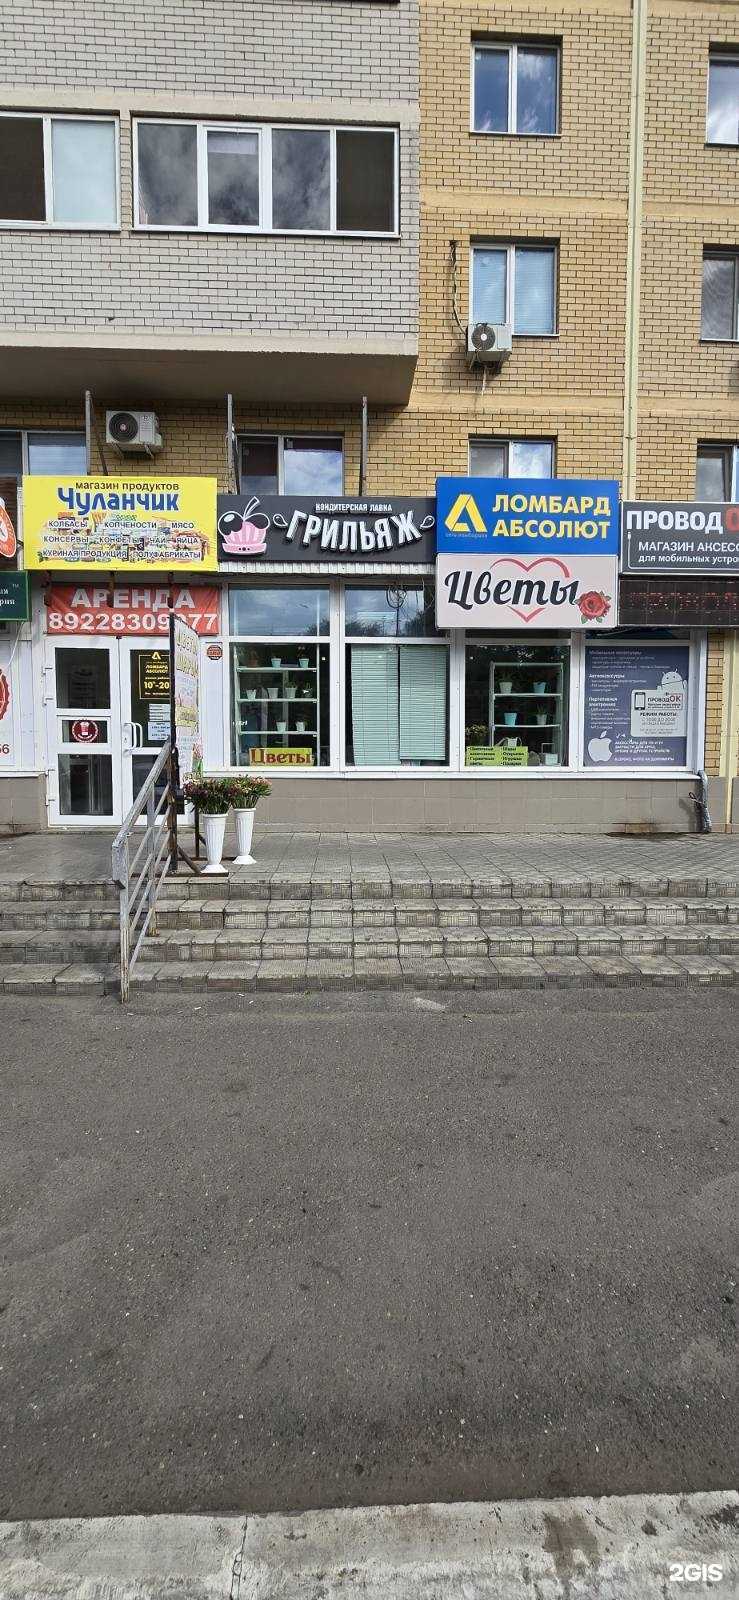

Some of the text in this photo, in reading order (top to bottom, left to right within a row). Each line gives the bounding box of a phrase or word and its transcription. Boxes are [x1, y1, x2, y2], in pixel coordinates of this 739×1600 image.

[76, 482, 180, 492] магазин продуктов
[58, 488, 180, 516] Чуланчик
[316, 504, 392, 512] КОНДИТЕРСКАЯ ЛАВКА
[492, 494, 611, 516] ЛОМБАРД
[48, 520, 88, 528] КОЛБАСЫ
[286, 510, 423, 552] ГРИЛЬЯЖ
[492, 520, 610, 540] АБСОЛЮТ
[99, 536, 140, 544] КОНФЕТЫ
[176, 536, 199, 545] ЯЙЦА
[638, 542, 696, 552] МАГАЗИН
[43, 550, 79, 558] КУРИНАЯ
[81, 550, 127, 560] ПРОДУКЦИЯ
[638, 555, 656, 564] для
[658, 553, 710, 564] мобильных
[70, 588, 196, 612] АРЕНДА
[444, 571, 580, 612] Цветы
[48, 612, 218, 631] 8922830977
[251, 748, 311, 765] Цветы
